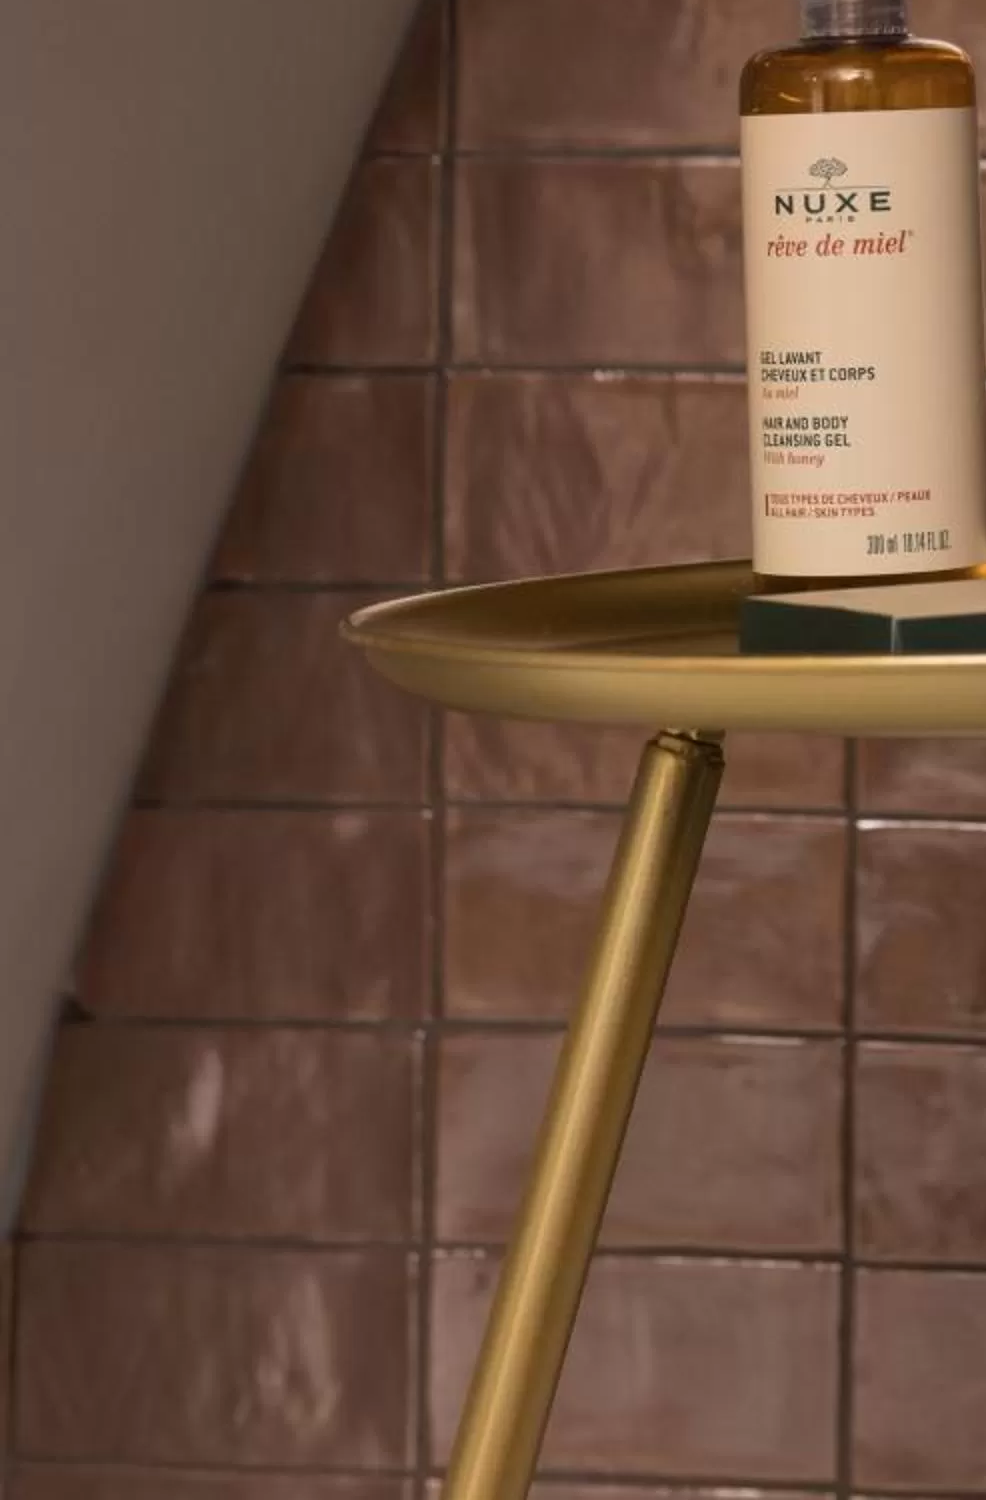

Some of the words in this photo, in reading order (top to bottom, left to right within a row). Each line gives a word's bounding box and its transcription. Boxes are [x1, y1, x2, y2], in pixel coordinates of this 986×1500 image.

[775, 191, 891, 215] NUXE
[767, 234, 807, 257] rêve
[816, 233, 844, 256] de
[760, 352, 777, 365] GEL
[779, 351, 822, 364] LAVANT
[761, 367, 807, 382] CHEVEUX
[810, 367, 826, 381] ET
[828, 366, 876, 381] CORPS
[762, 417, 784, 430] HAIR
[785, 416, 809, 430] AND
[812, 415, 849, 429] BODY
[763, 433, 821, 447] CLEANSING
[825, 433, 851, 447] GEL
[791, 493, 819, 505] TYPES
[821, 493, 836, 504] DE
[837, 492, 888, 504] CHEVEUX
[814, 506, 838, 518] SKIN
[840, 506, 875, 517] TYPES
